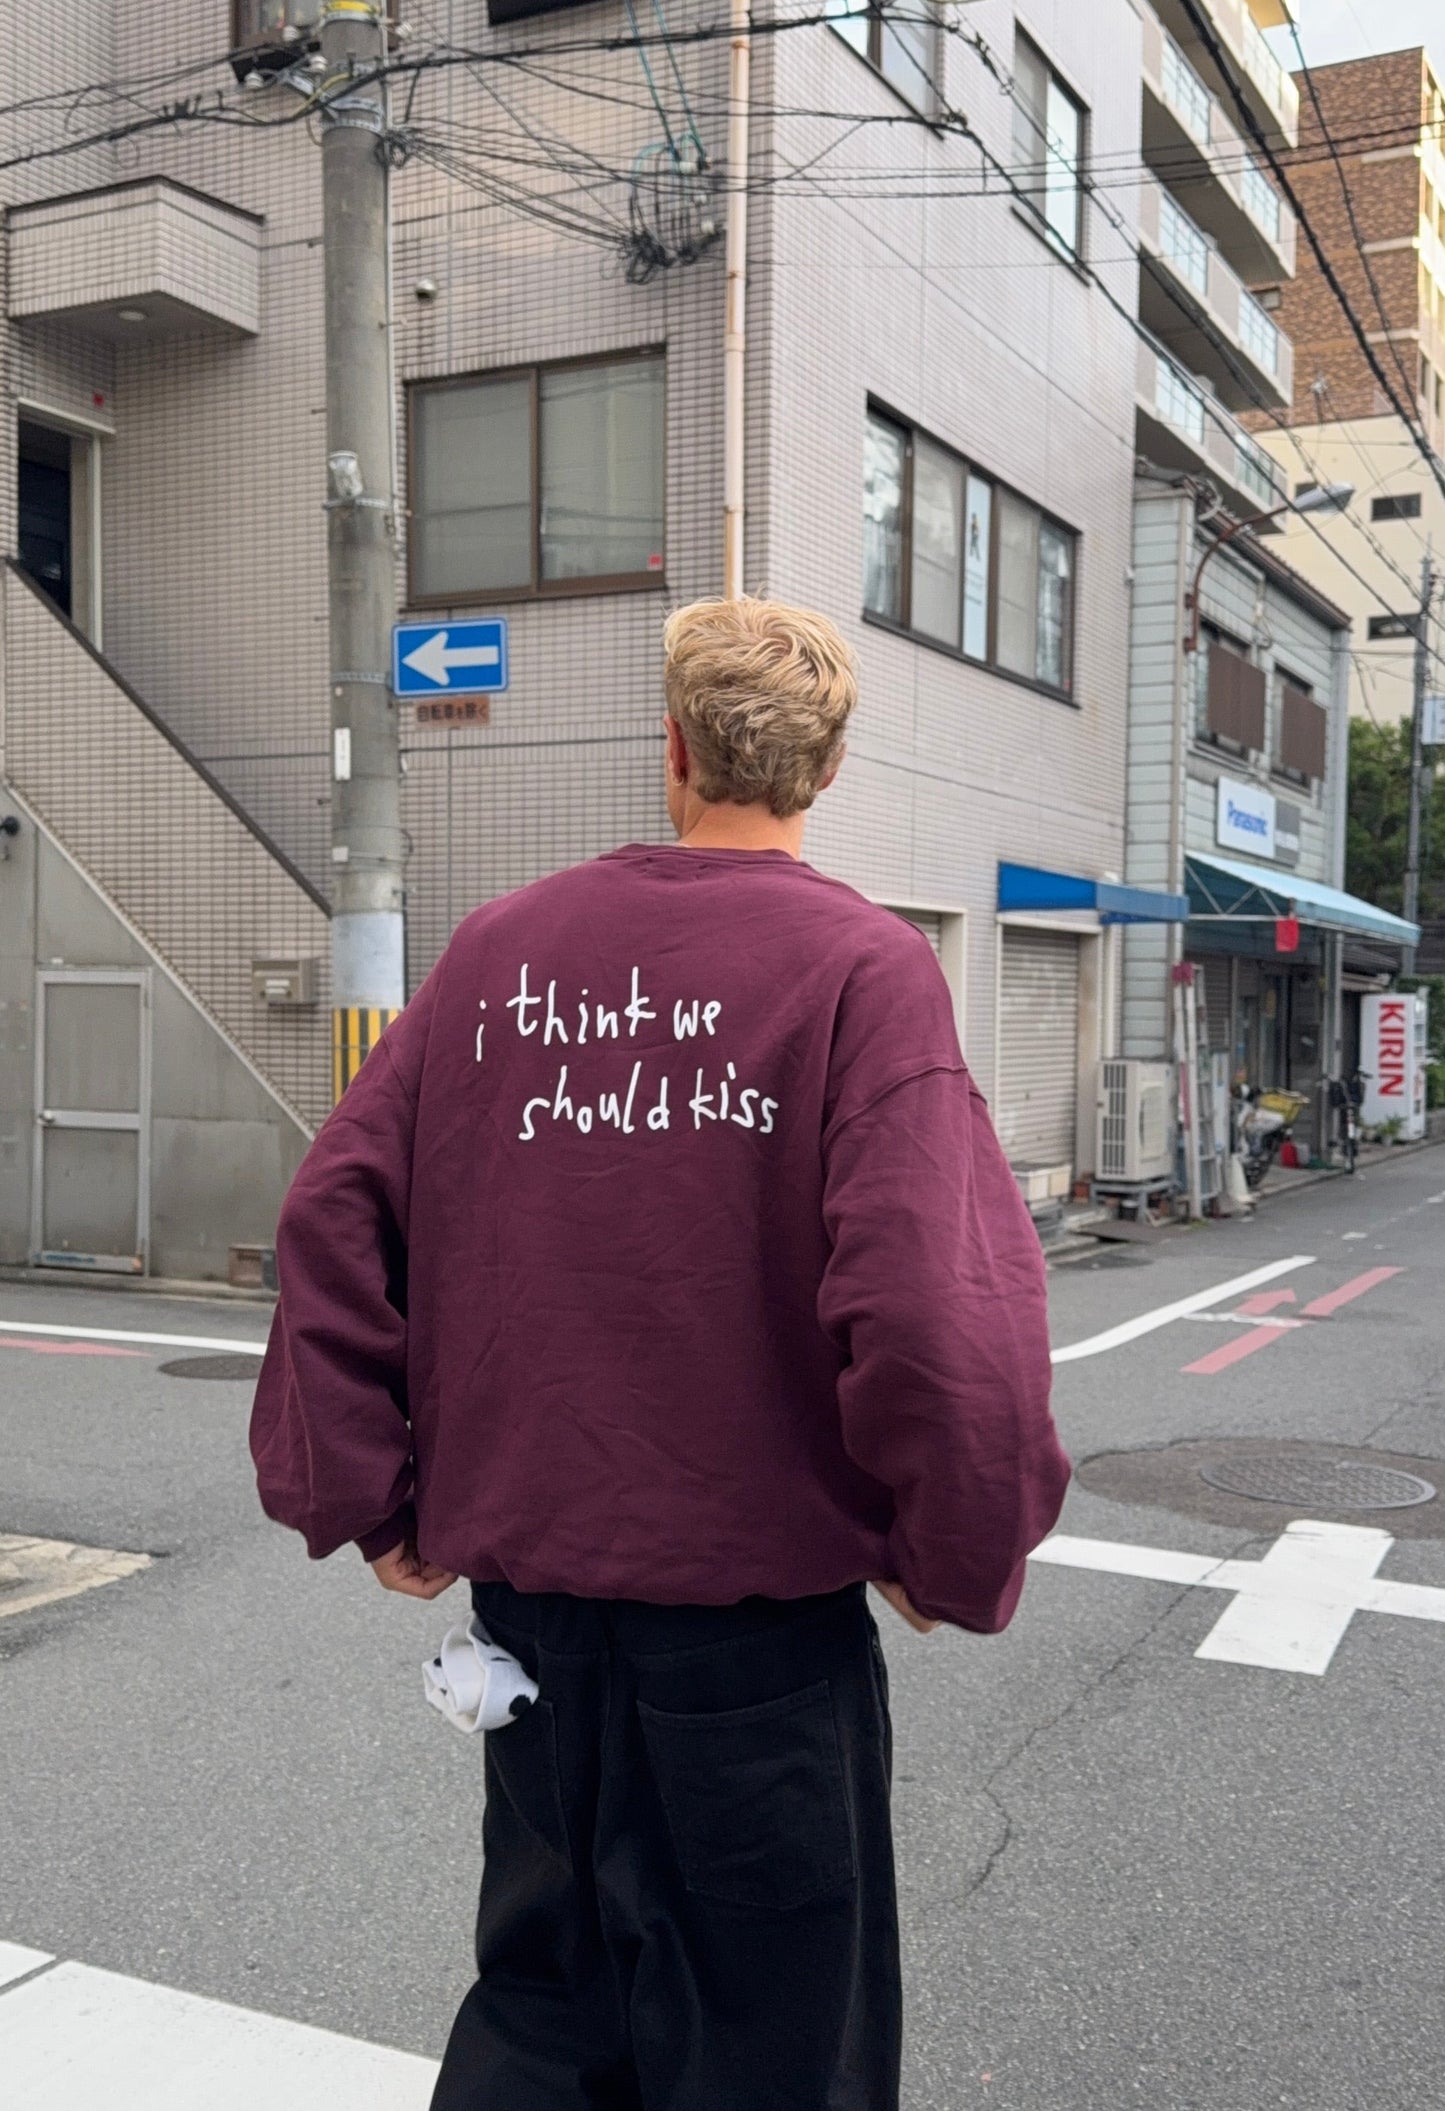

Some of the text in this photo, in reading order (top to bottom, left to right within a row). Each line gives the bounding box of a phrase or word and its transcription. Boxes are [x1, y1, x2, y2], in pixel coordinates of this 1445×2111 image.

[476, 963, 721, 1062] i think we
[1379, 1003, 1405, 1095] KIRIN
[518, 1061, 779, 1141] should kiss
